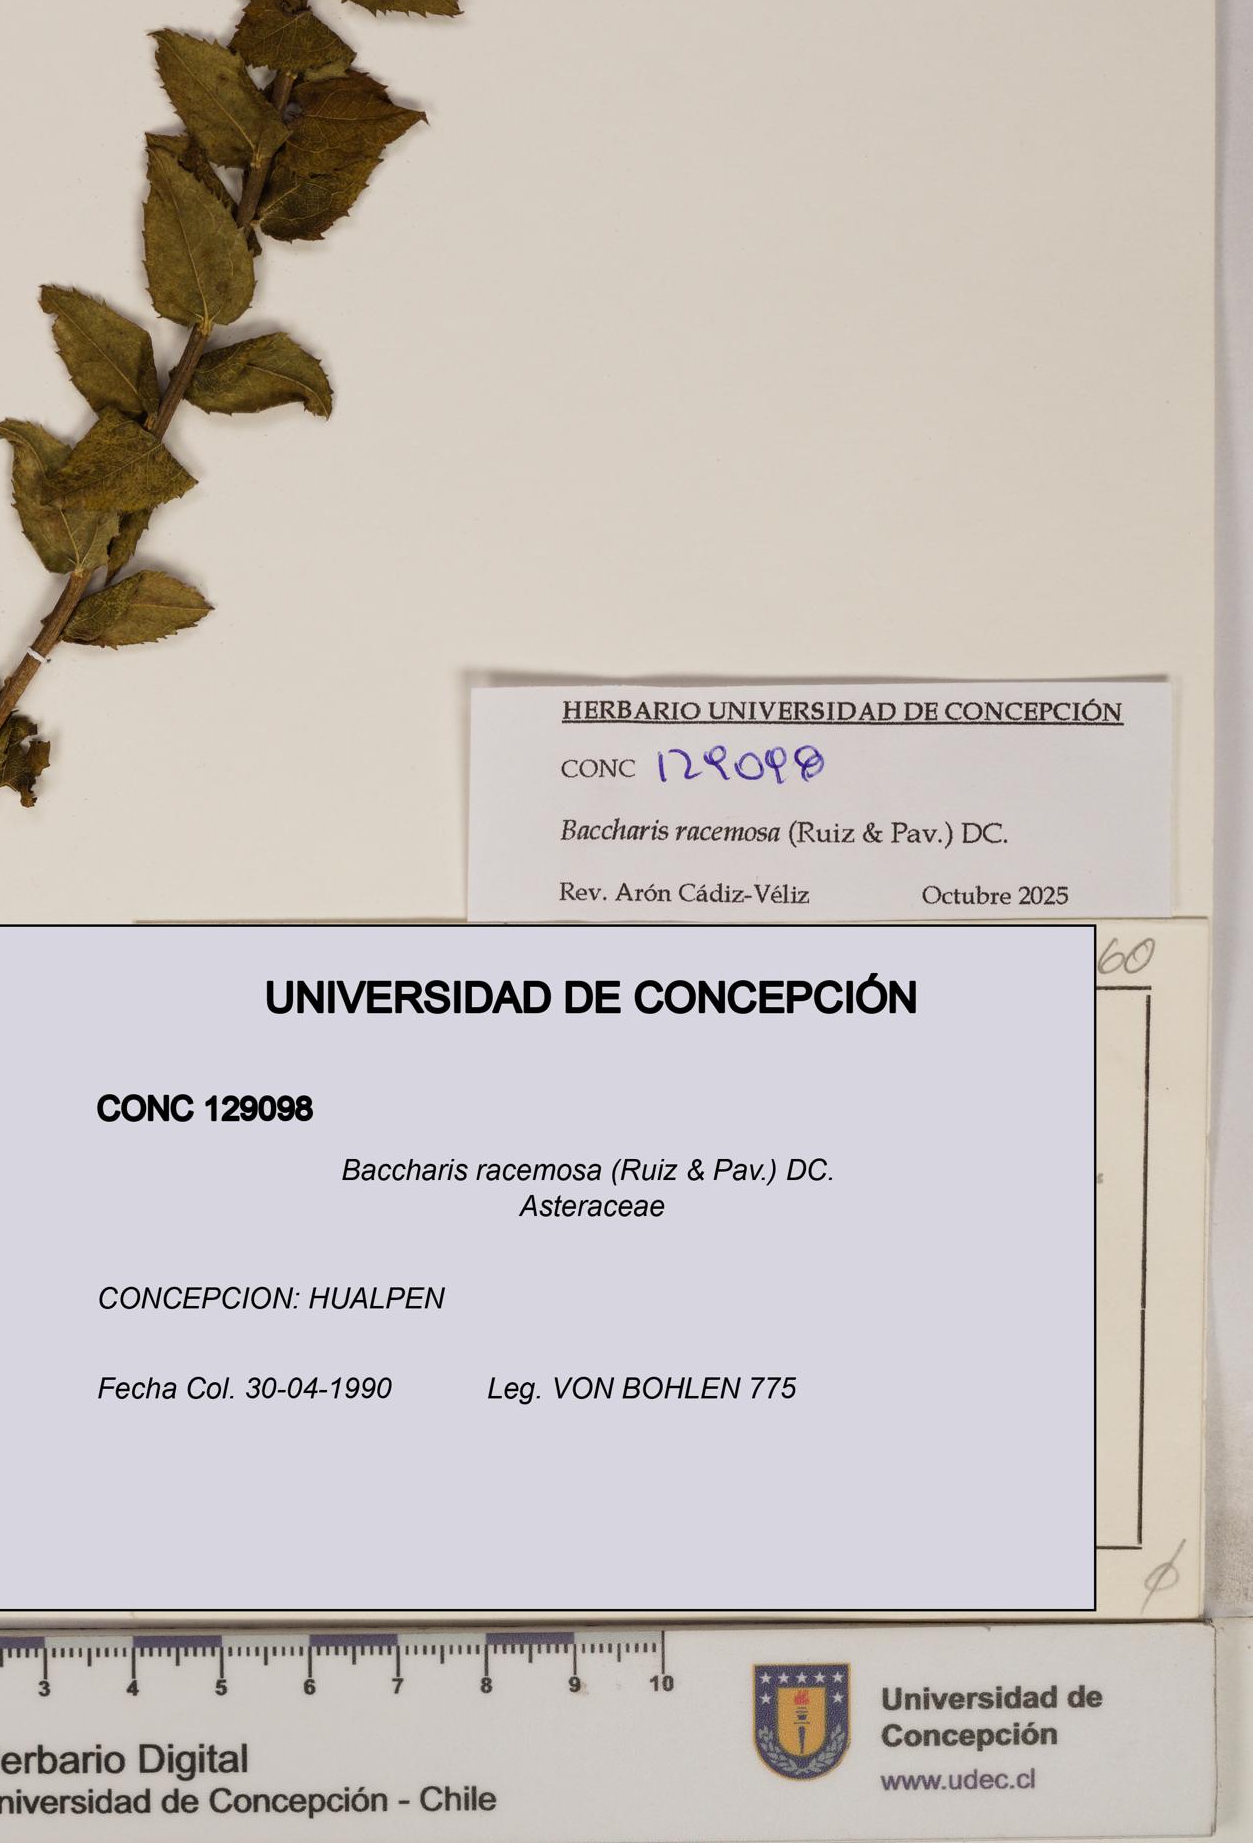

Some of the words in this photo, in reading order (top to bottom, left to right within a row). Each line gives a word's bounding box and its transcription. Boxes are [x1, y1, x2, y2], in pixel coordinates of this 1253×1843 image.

[562, 700, 702, 722] HERBARIO
[708, 701, 897, 722] UNIVERSIDAD
[903, 701, 939, 722] DE
[944, 698, 1123, 722] CONCEPCIÓN
[561, 758, 636, 779] CONC
[560, 817, 669, 841] Baccharis
[675, 825, 781, 843] racemosa
[788, 819, 855, 849] (Ruiz
[862, 821, 884, 844] &
[890, 821, 954, 850] Pav.)
[961, 822, 1008, 844] DC.
[559, 881, 607, 901] Rev.
[615, 882, 672, 902] Arón
[678, 882, 810, 904] Cádiz-Véliz
[922, 884, 1012, 906] Octubre
[1018, 885, 1069, 906] 2025
[38, 1680, 51, 1698] 3
[125, 1679, 140, 1697] 4
[214, 1679, 228, 1697] 5
[303, 1678, 317, 1696] 6
[391, 1677, 405, 1695] 7
[480, 1676, 493, 1694] 8
[568, 1676, 582, 1694] 9
[649, 1674, 675, 1692] 10
[882, 1684, 1058, 1711] Universidad
[1066, 1684, 1103, 1709] de
[880, 1721, 1058, 1752] Concepción
[138, 1743, 248, 1780] Digital
[880, 1767, 1036, 1791] www.udec.cl
[161, 1787, 200, 1814] de
[209, 1786, 388, 1819] Concepción
[419, 1785, 497, 1812] Chile
